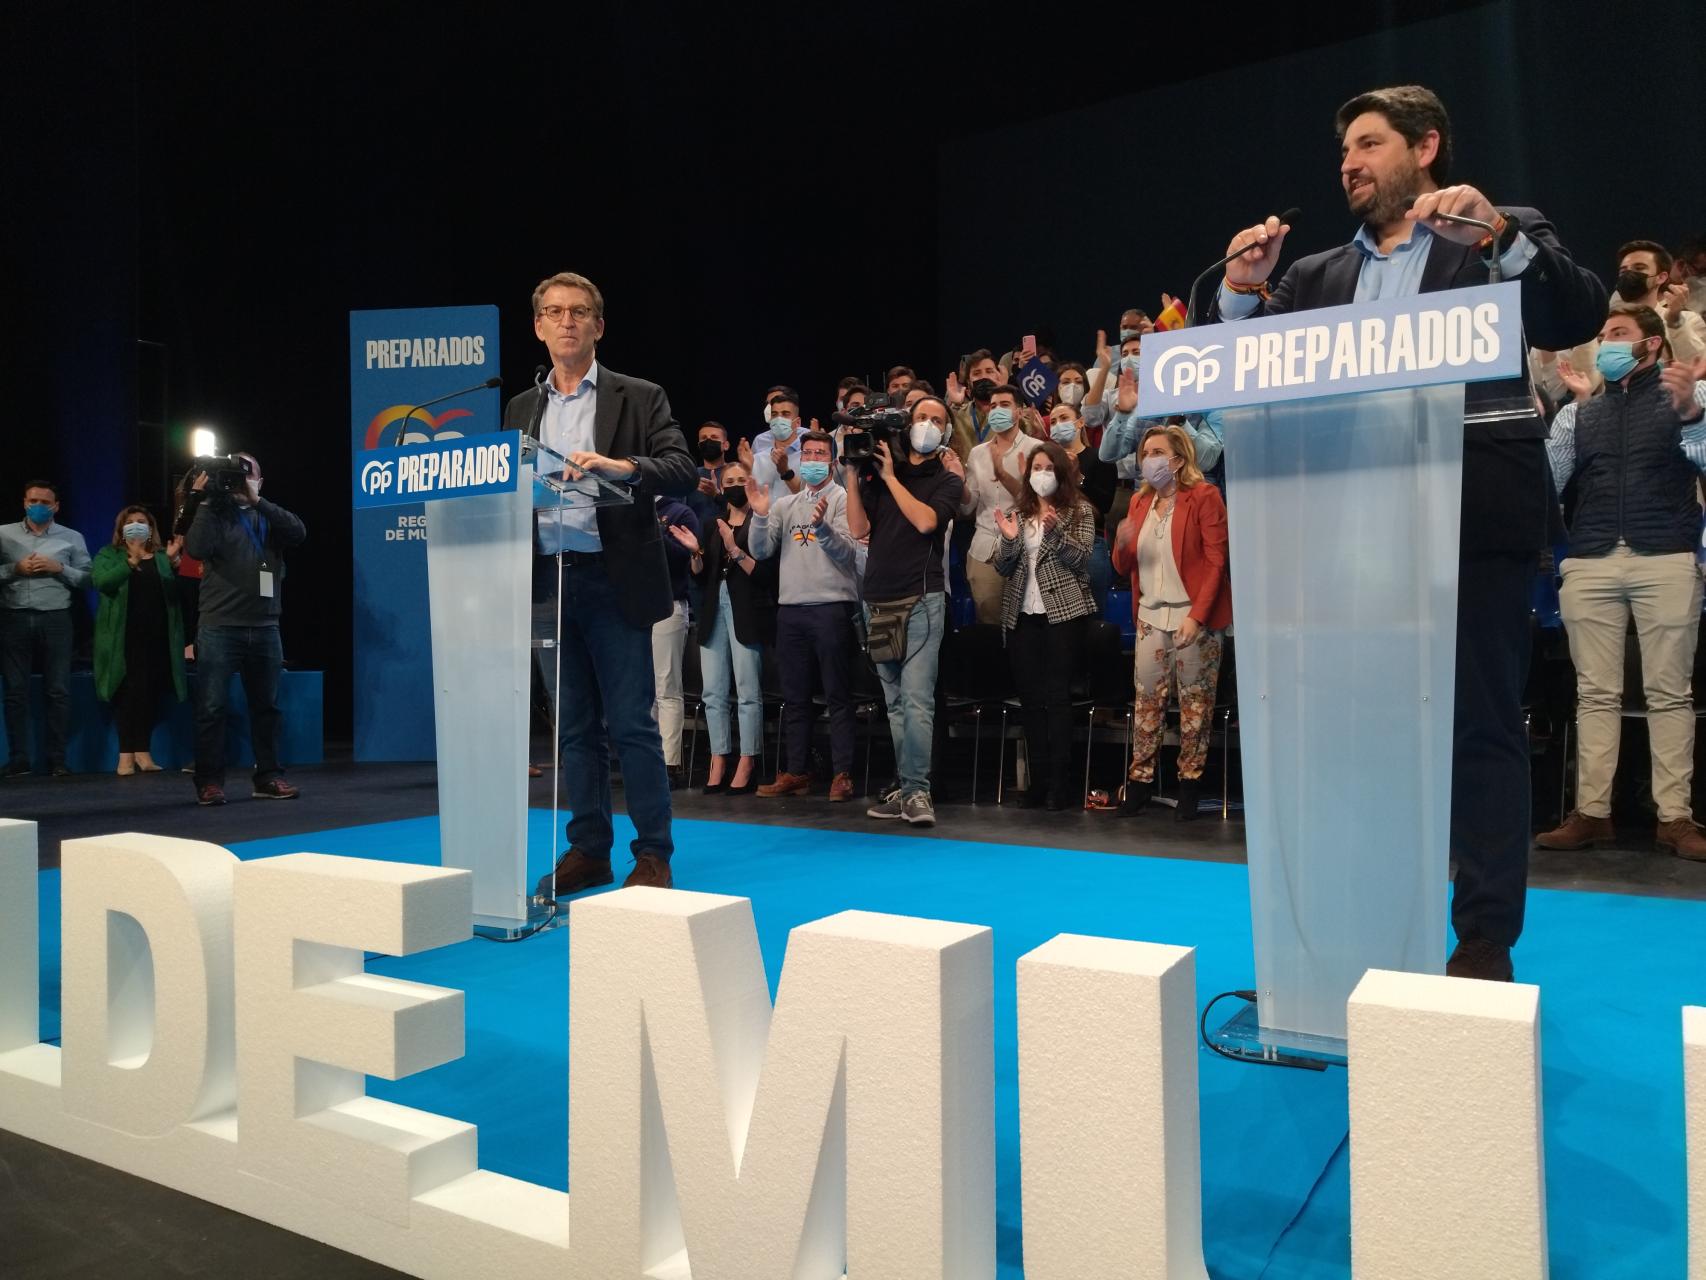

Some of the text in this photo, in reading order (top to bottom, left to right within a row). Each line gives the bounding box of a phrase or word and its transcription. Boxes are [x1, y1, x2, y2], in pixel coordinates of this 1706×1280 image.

[366, 335, 485, 369] PREPARADOS
[1234, 302, 1500, 392] PREPARADOS
[397, 443, 510, 494] PREPARADOS
[385, 528, 428, 541] DE MU
[398, 515, 427, 528] REG
[60, 832, 478, 1228] DE
